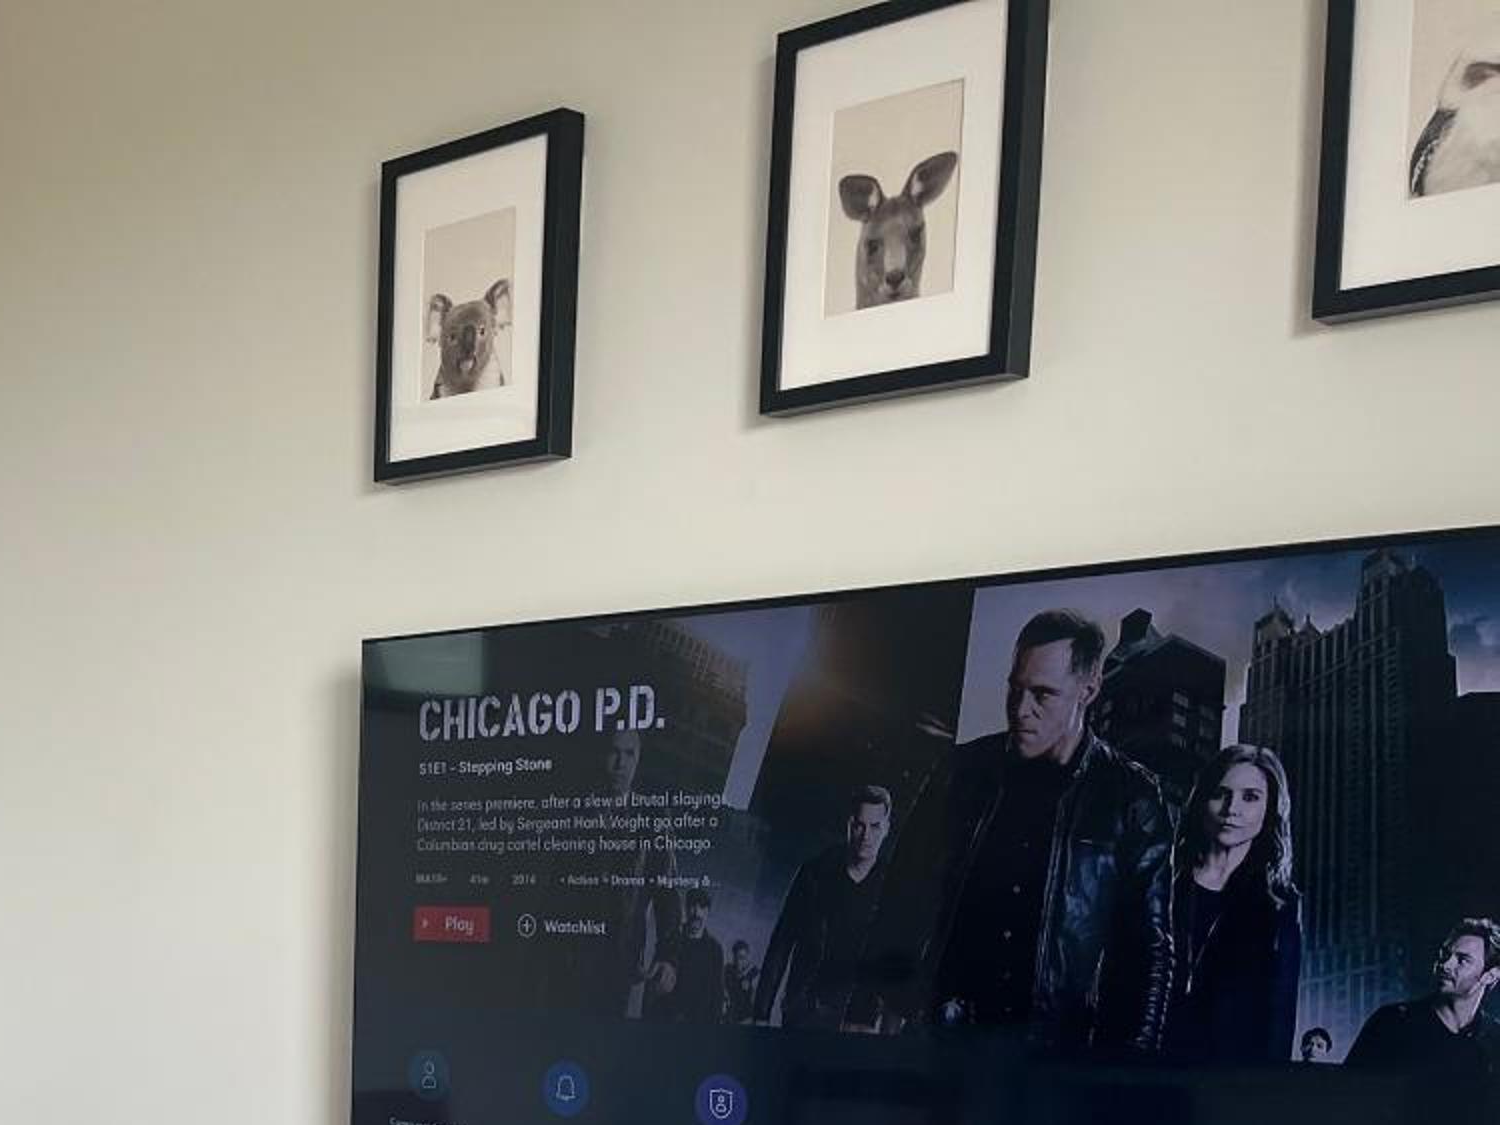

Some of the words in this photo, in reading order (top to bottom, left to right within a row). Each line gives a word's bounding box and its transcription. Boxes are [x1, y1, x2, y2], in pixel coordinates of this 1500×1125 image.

[419, 689, 580, 741] CHICAGO
[595, 685, 665, 732] P.D.
[458, 759, 513, 776] Stepping
[515, 757, 552, 771] Stone
[541, 794, 570, 809] after
[573, 797, 581, 808] a
[615, 792, 628, 807] of
[631, 791, 669, 807] brutal
[479, 816, 497, 831] led
[500, 816, 515, 834] by
[517, 814, 571, 833] Sergeant
[574, 814, 605, 829] Hank
[653, 816, 671, 832] go
[674, 812, 705, 828] after
[709, 818, 719, 828] a
[478, 838, 505, 854] drug
[507, 836, 541, 851] cartel
[544, 835, 595, 854] cleaning
[599, 835, 636, 850] house
[639, 836, 650, 849] in
[445, 916, 475, 936] Play
[544, 919, 606, 935] Watchlist
